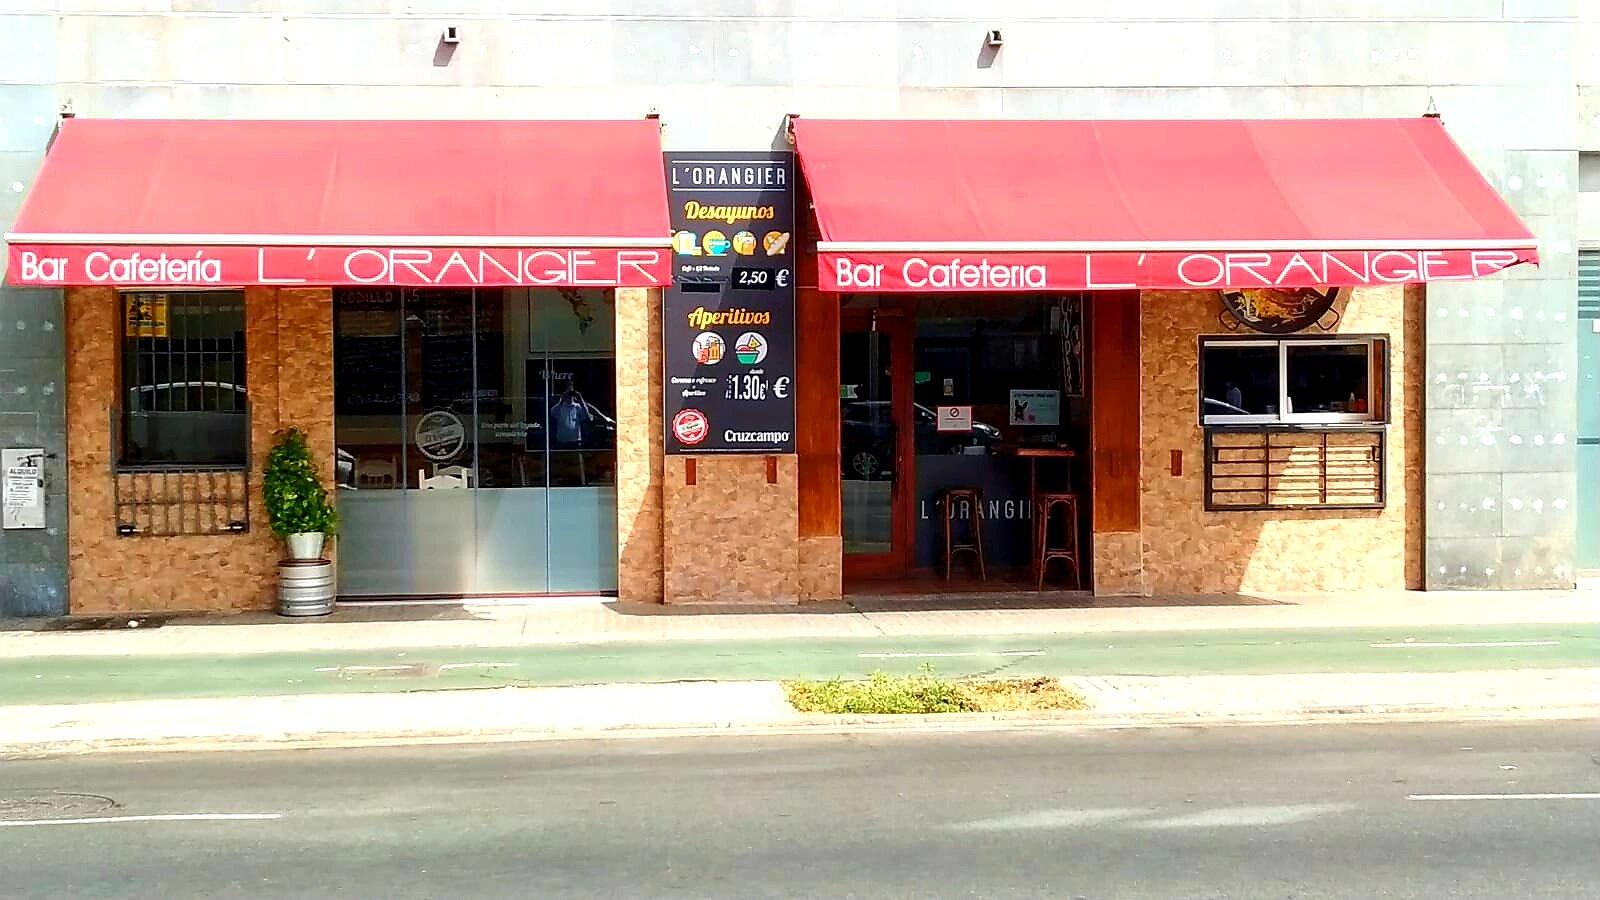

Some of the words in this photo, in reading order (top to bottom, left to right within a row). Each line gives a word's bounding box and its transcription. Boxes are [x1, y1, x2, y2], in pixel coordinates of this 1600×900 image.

[671, 167, 786, 185] L'ORANGIER
[684, 200, 774, 224] Desayunos
[21, 251, 68, 281] Bar
[84, 250, 221, 282] Cafetería
[739, 270, 768, 285] 2,50
[775, 268, 790, 287] €
[836, 258, 885, 287] Bar
[687, 306, 770, 330] Aperitivos
[772, 376, 790, 398] €
[724, 429, 790, 443] Cruzcampo
